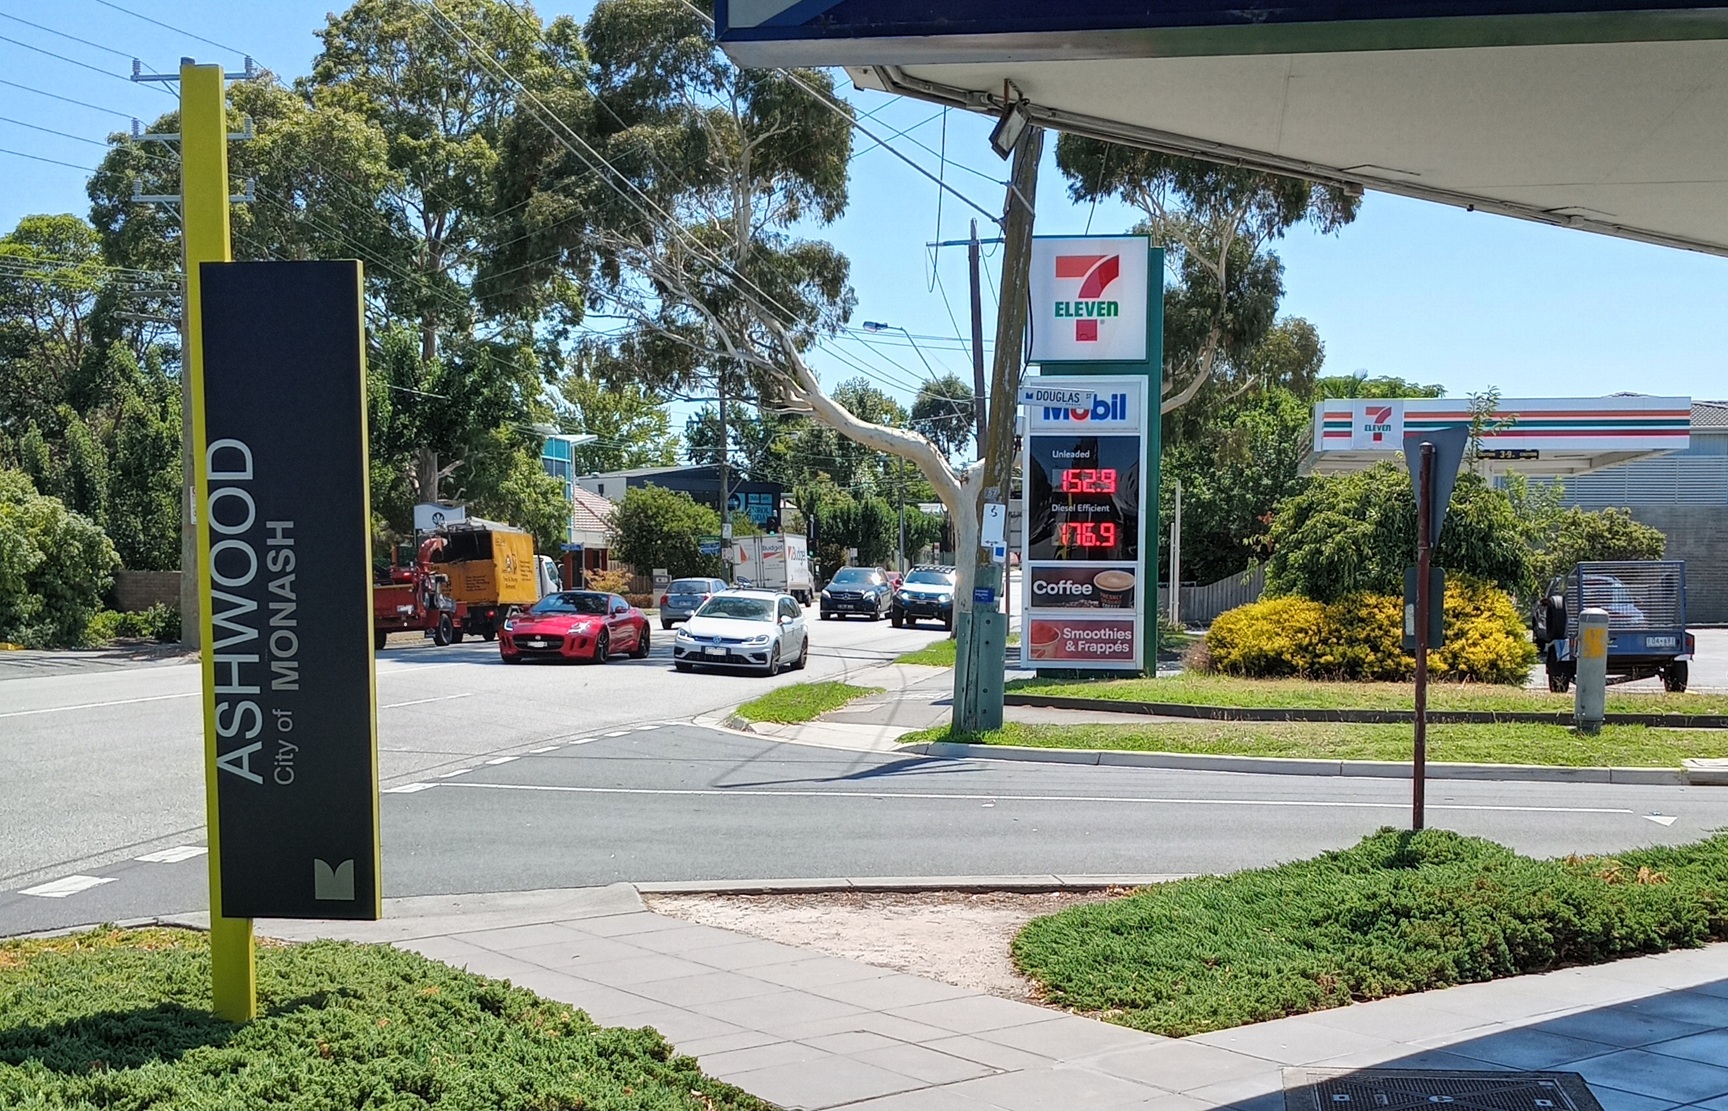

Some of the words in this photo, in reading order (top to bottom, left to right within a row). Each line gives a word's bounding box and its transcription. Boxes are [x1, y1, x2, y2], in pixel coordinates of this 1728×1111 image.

[1055, 254, 1120, 342] 7
[1036, 390, 1080, 403] DOUGLAS
[1051, 450, 1090, 459] Unleaded
[1062, 469, 1117, 493] 152.9
[1051, 503, 1076, 512] Diesel
[1077, 503, 1110, 512] Efficient
[1061, 522, 1115, 546] 176.9
[1033, 580, 1092, 594] Coffee
[206, 437, 265, 785] ASHWOOD
[266, 520, 300, 692] MONASH
[1063, 627, 1132, 640] Smoothies
[1065, 641, 1076, 652] &
[1078, 640, 1130, 655] Frappés
[272, 707, 294, 734] of
[273, 739, 299, 786] City
